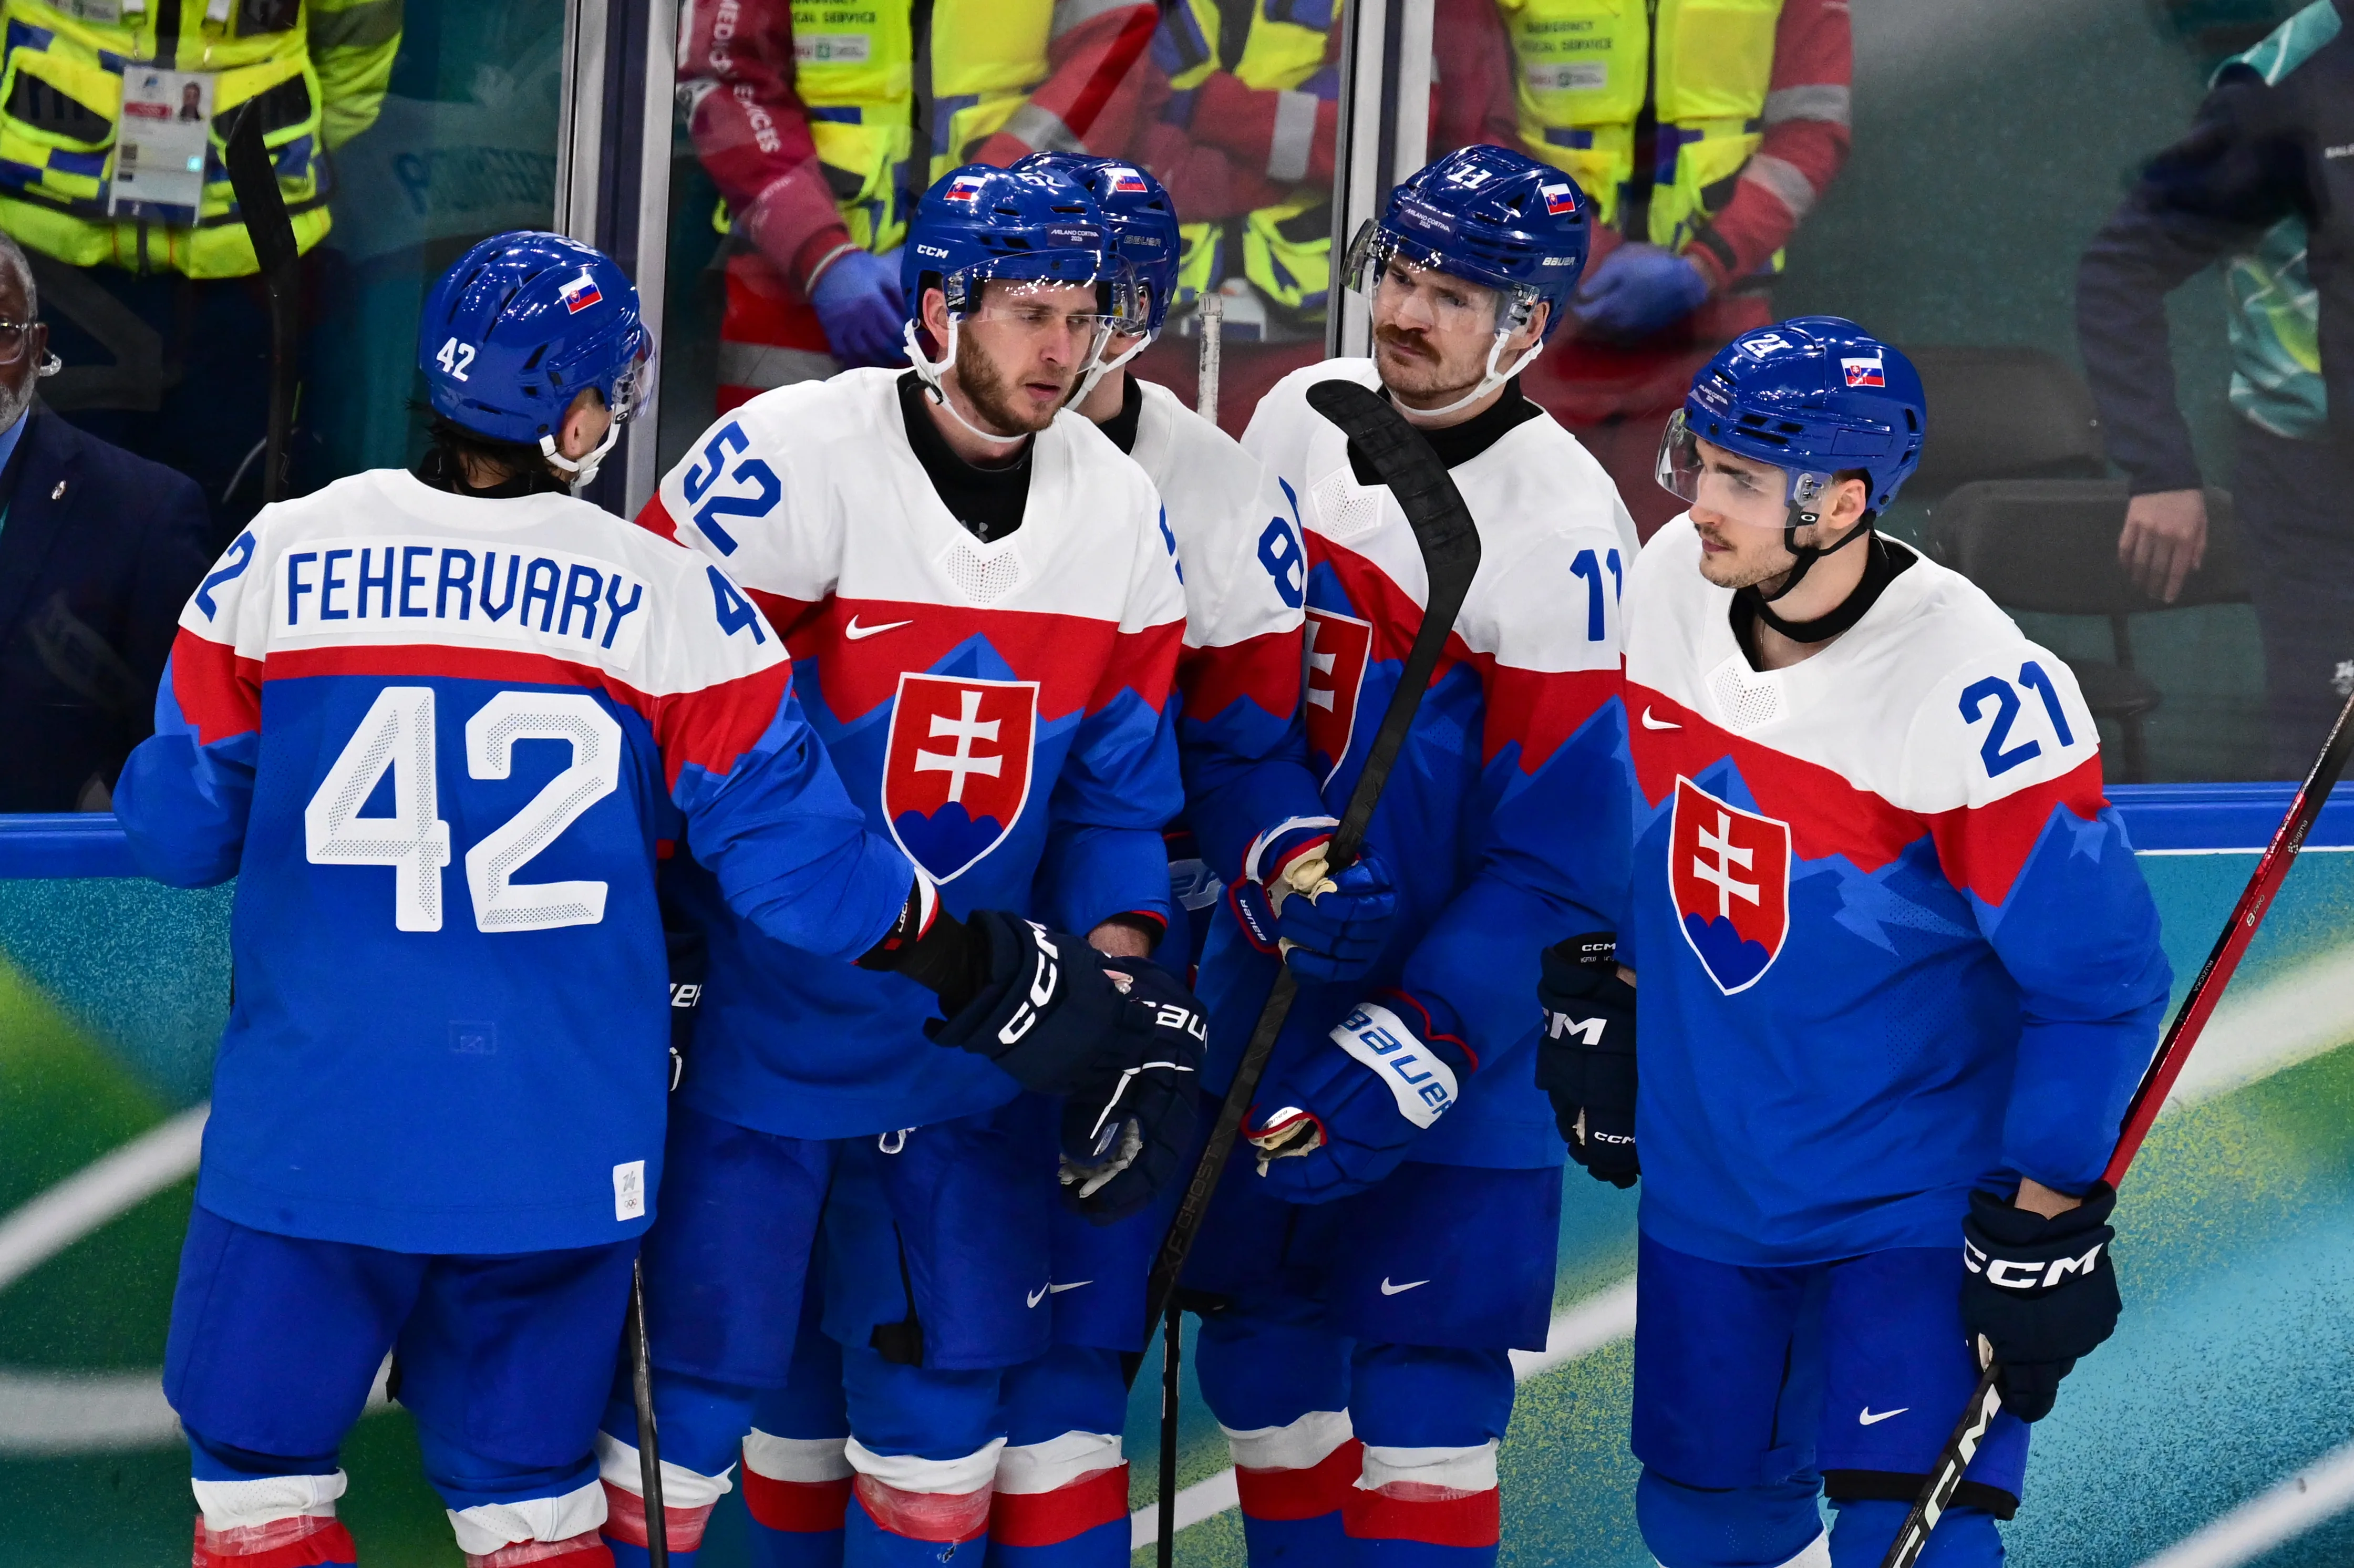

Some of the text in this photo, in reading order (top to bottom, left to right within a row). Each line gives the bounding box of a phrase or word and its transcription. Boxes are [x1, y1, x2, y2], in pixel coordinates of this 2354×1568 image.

[1447, 164, 1493, 189] 11
[1406, 208, 1450, 232] MILANO CORTINA
[1419, 220, 1431, 229] 2026
[917, 244, 949, 259] CCM
[1542, 256, 1575, 266] BAUER
[436, 337, 476, 383] 42
[1742, 334, 1791, 358] 21
[683, 420, 781, 557] 52
[1257, 476, 1307, 608] 8
[287, 546, 643, 649] FEHERVARY
[1958, 661, 2074, 778] 21
[305, 686, 622, 933] 42
[1240, 899, 1267, 941] BAUER
[1582, 943, 1616, 952] CCM
[998, 919, 1060, 1045] CCM
[2193, 960, 2214, 992] RUZICKA
[1963, 1236, 2104, 1288] CCM
